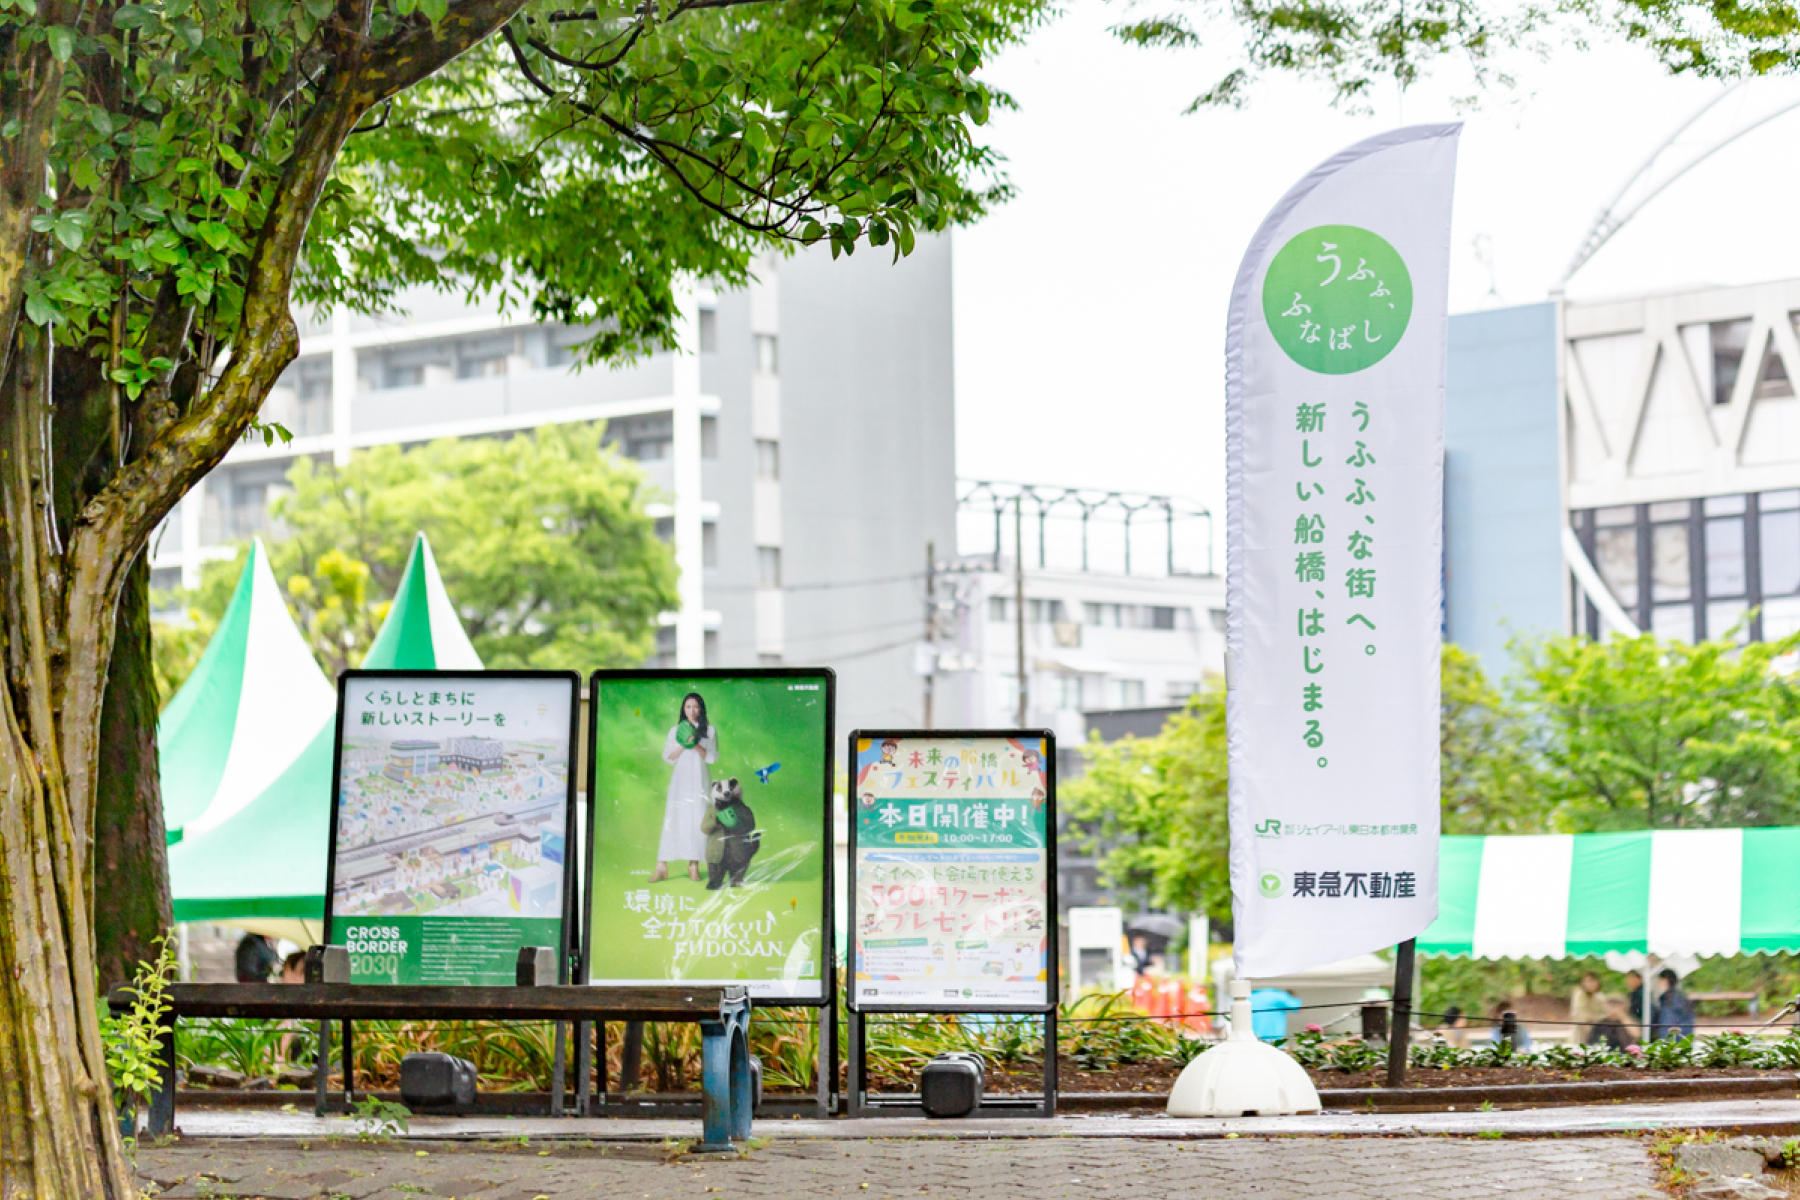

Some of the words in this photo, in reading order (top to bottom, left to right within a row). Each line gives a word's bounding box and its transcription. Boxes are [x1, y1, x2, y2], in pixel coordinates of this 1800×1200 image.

[1316, 241, 1395, 309] うふふ、
[1281, 292, 1383, 350] ふなばし
[1345, 401, 1377, 656] うふふ、な街へ。
[1294, 402, 1328, 769] 新しい船橋、はじまる。
[364, 690, 476, 706] くらしとまちに
[360, 710, 507, 727] 新しいストーリーを
[908, 747, 998, 769] 未来の船橋
[884, 769, 1020, 792] フェスティバル
[878, 802, 1028, 829] 本日開催中!
[1254, 818, 1282, 836] JR
[870, 884, 1035, 907] 500円クーポン
[1292, 870, 1417, 899] 東急不動産
[346, 925, 400, 939] CROSS
[346, 940, 409, 954] BORDER
[350, 954, 398, 975] 2030
